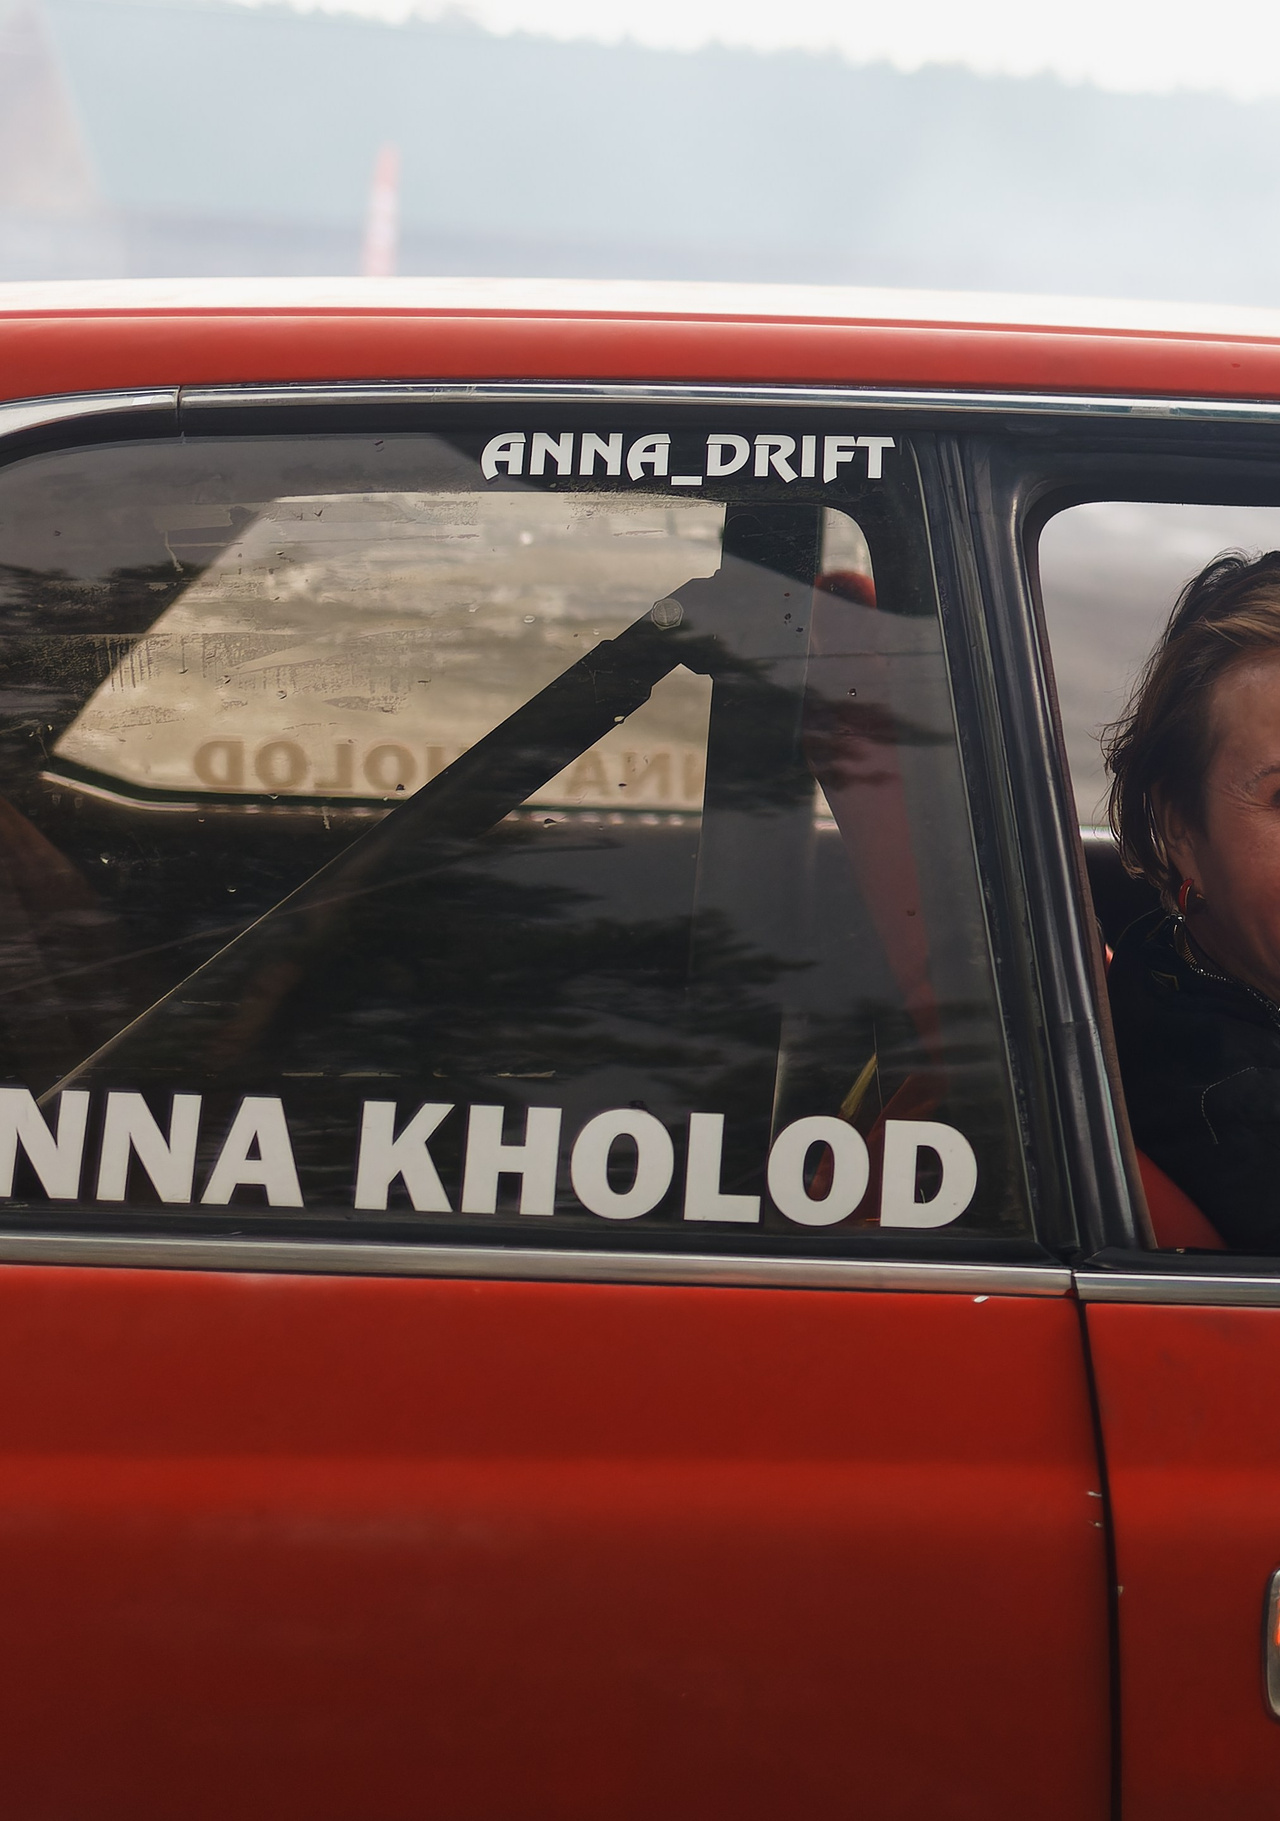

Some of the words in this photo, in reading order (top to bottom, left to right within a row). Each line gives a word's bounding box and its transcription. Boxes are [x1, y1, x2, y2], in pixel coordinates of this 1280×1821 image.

[480, 432, 896, 486] ANNA_DRIFT
[0, 1087, 304, 1207] NNA
[354, 1100, 978, 1229] KHOLOD
